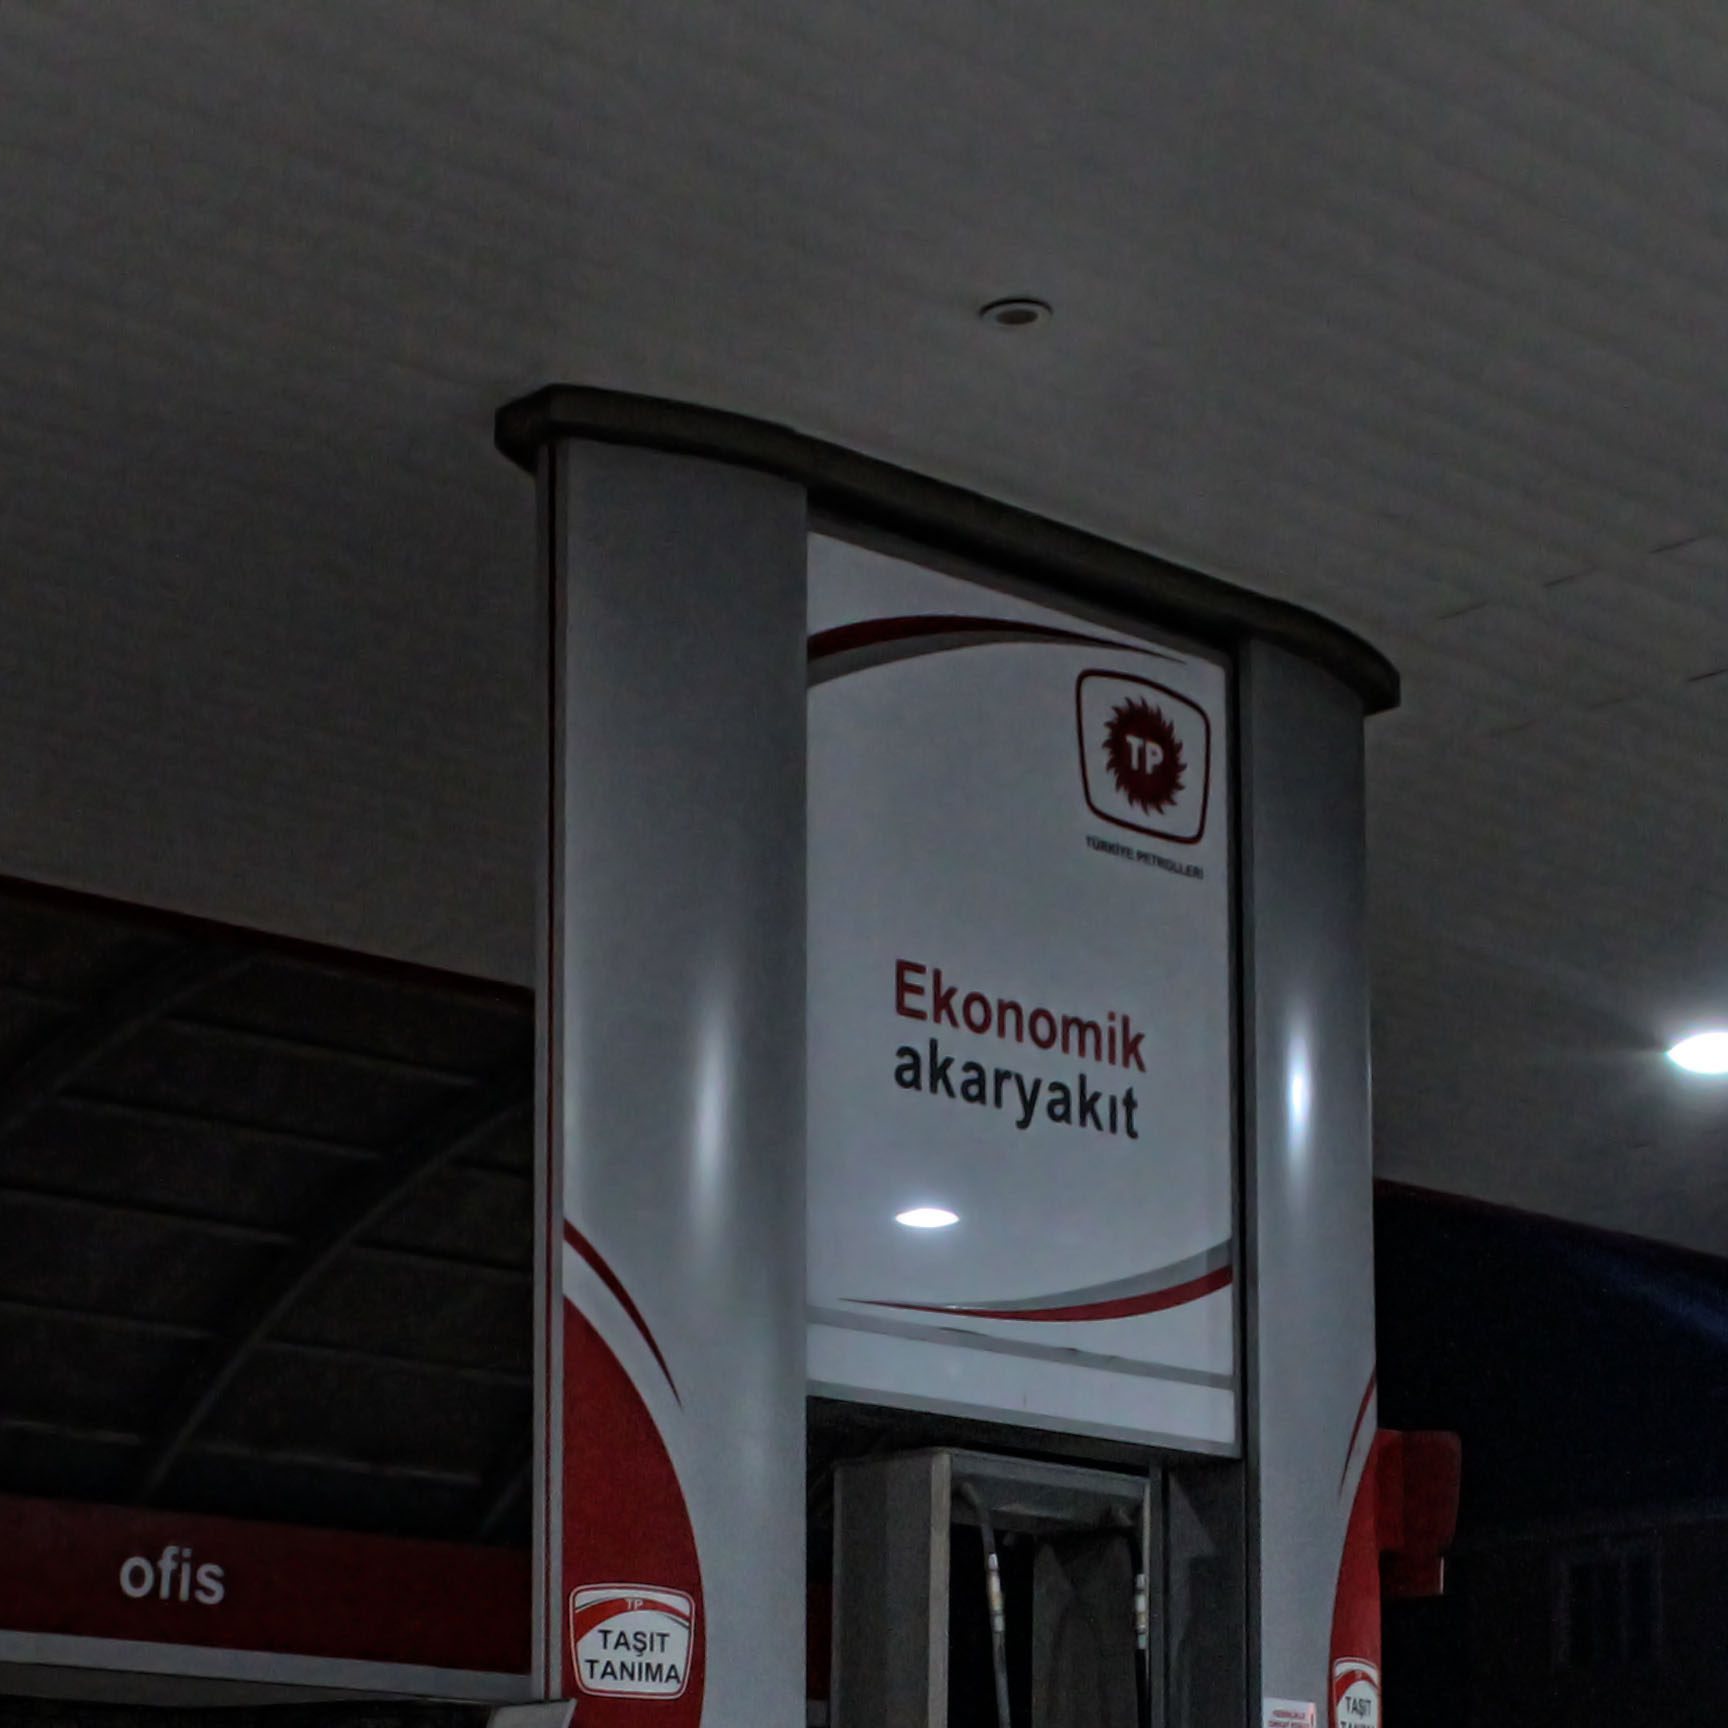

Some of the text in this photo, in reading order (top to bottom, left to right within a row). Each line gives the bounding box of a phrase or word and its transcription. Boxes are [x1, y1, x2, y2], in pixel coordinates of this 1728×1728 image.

[1125, 733, 1164, 775] TP
[895, 958, 1147, 1073] Ekonomik
[894, 1037, 1139, 1139] akaryakıt
[119, 1544, 225, 1605] ofis
[624, 1598, 644, 1610] TP
[598, 1629, 670, 1657] TAŞIT
[584, 1659, 681, 1684] TANIMA
[1345, 1695, 1372, 1718] TAŞIT
